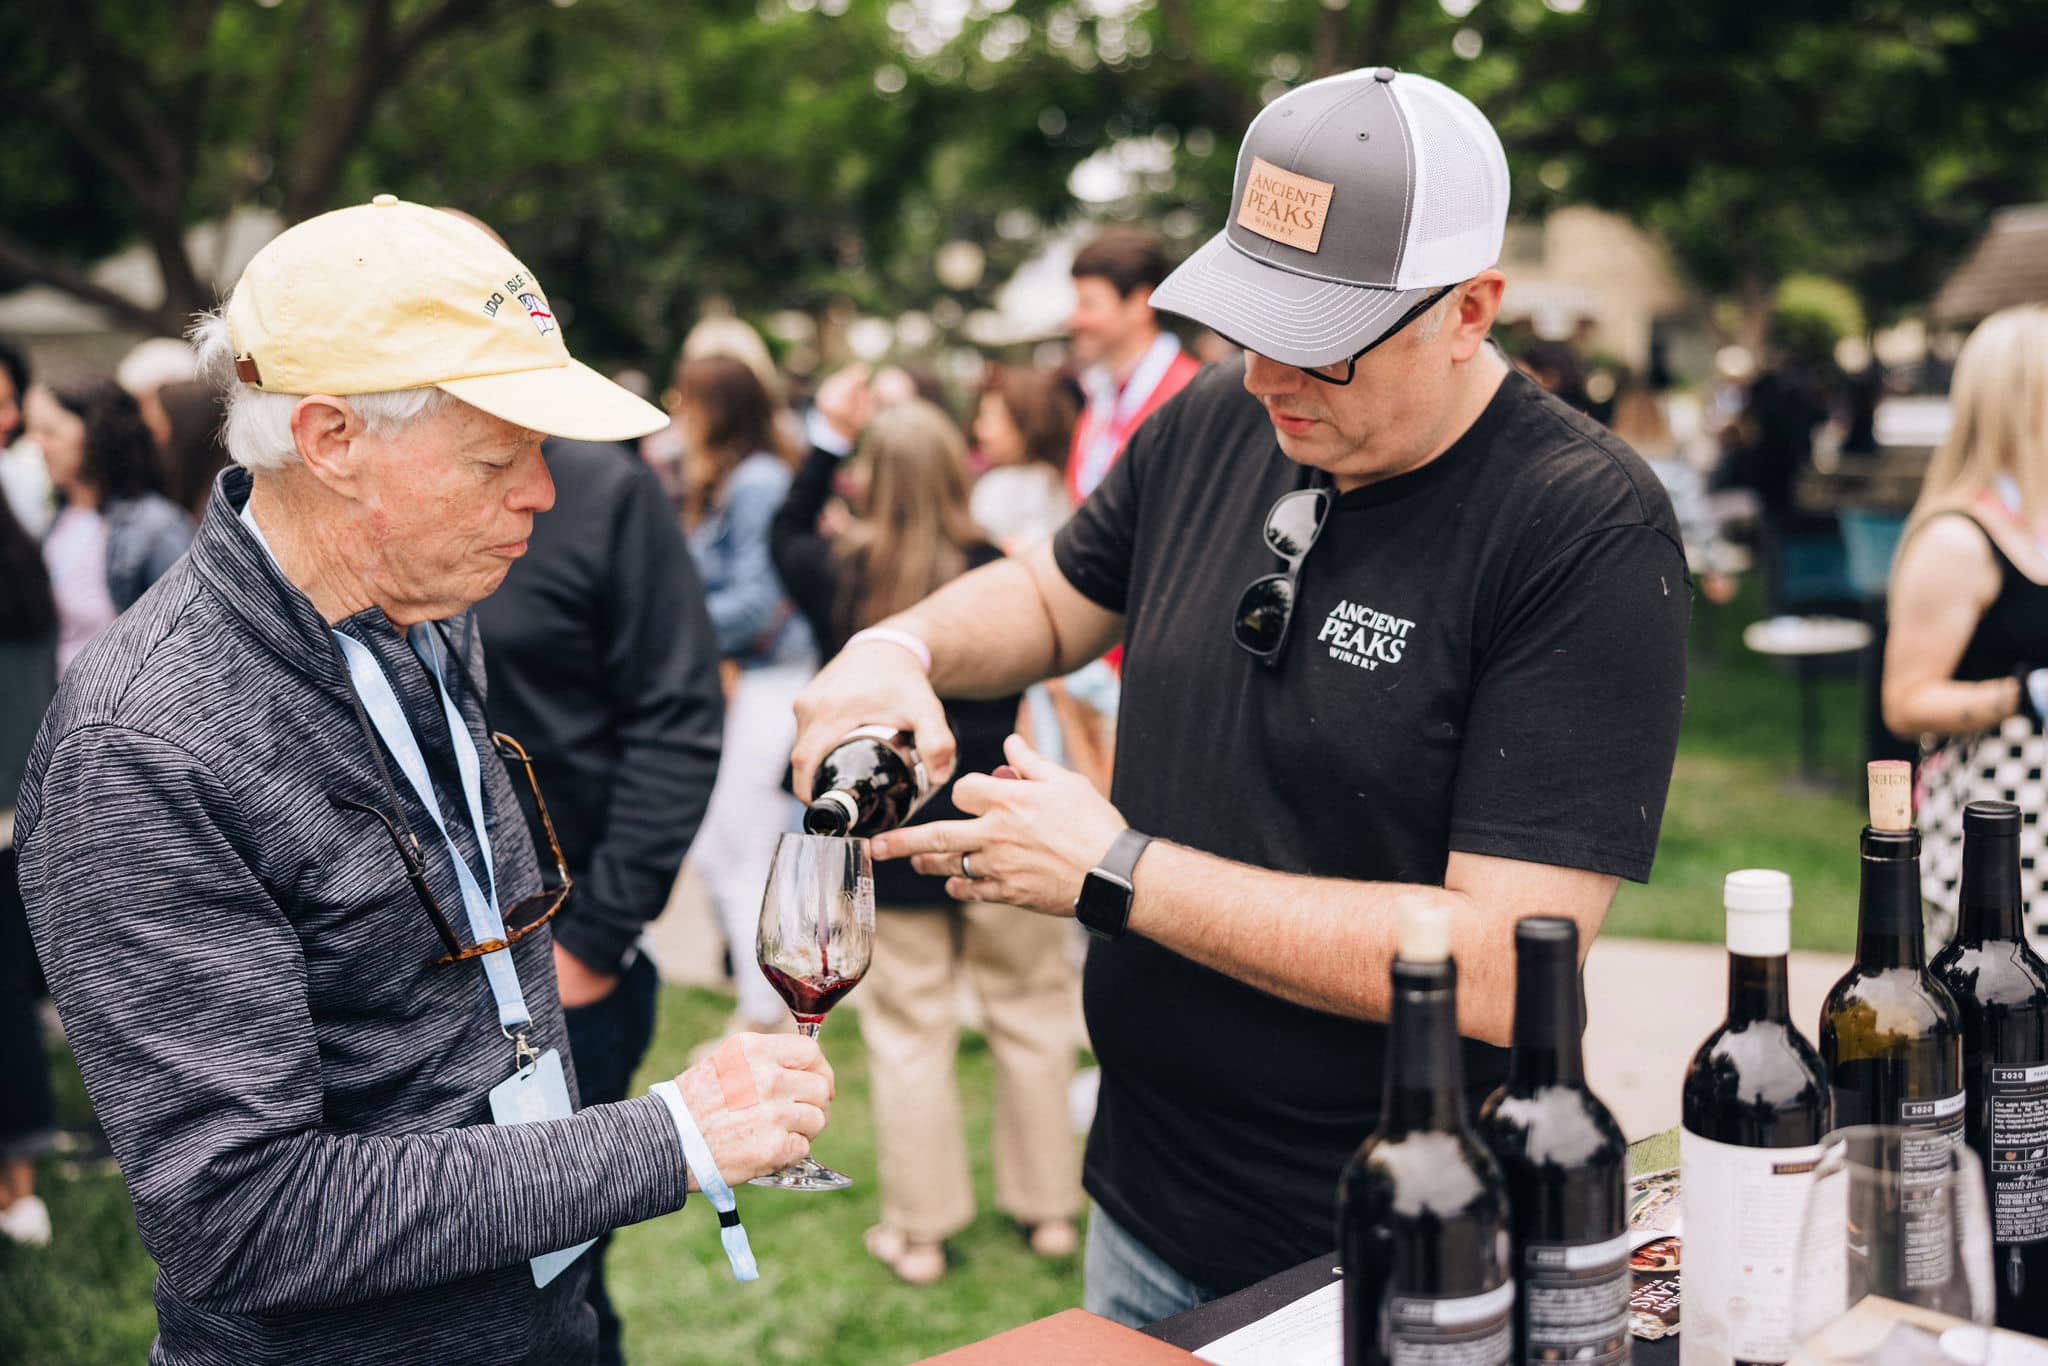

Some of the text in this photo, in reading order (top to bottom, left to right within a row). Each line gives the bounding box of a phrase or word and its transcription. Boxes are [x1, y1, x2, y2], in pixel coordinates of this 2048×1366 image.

[1252, 173, 1321, 207] ANCIENT
[1247, 189, 1316, 230] PEAKS
[1255, 214, 1294, 236] WINERY
[1329, 599, 1416, 638] ANCIENT
[1317, 616, 1406, 664] PEAKS
[1329, 646, 1379, 671] WINERY
[2001, 1072, 2024, 1080] 2020
[1911, 1105, 1933, 1115] 2020
